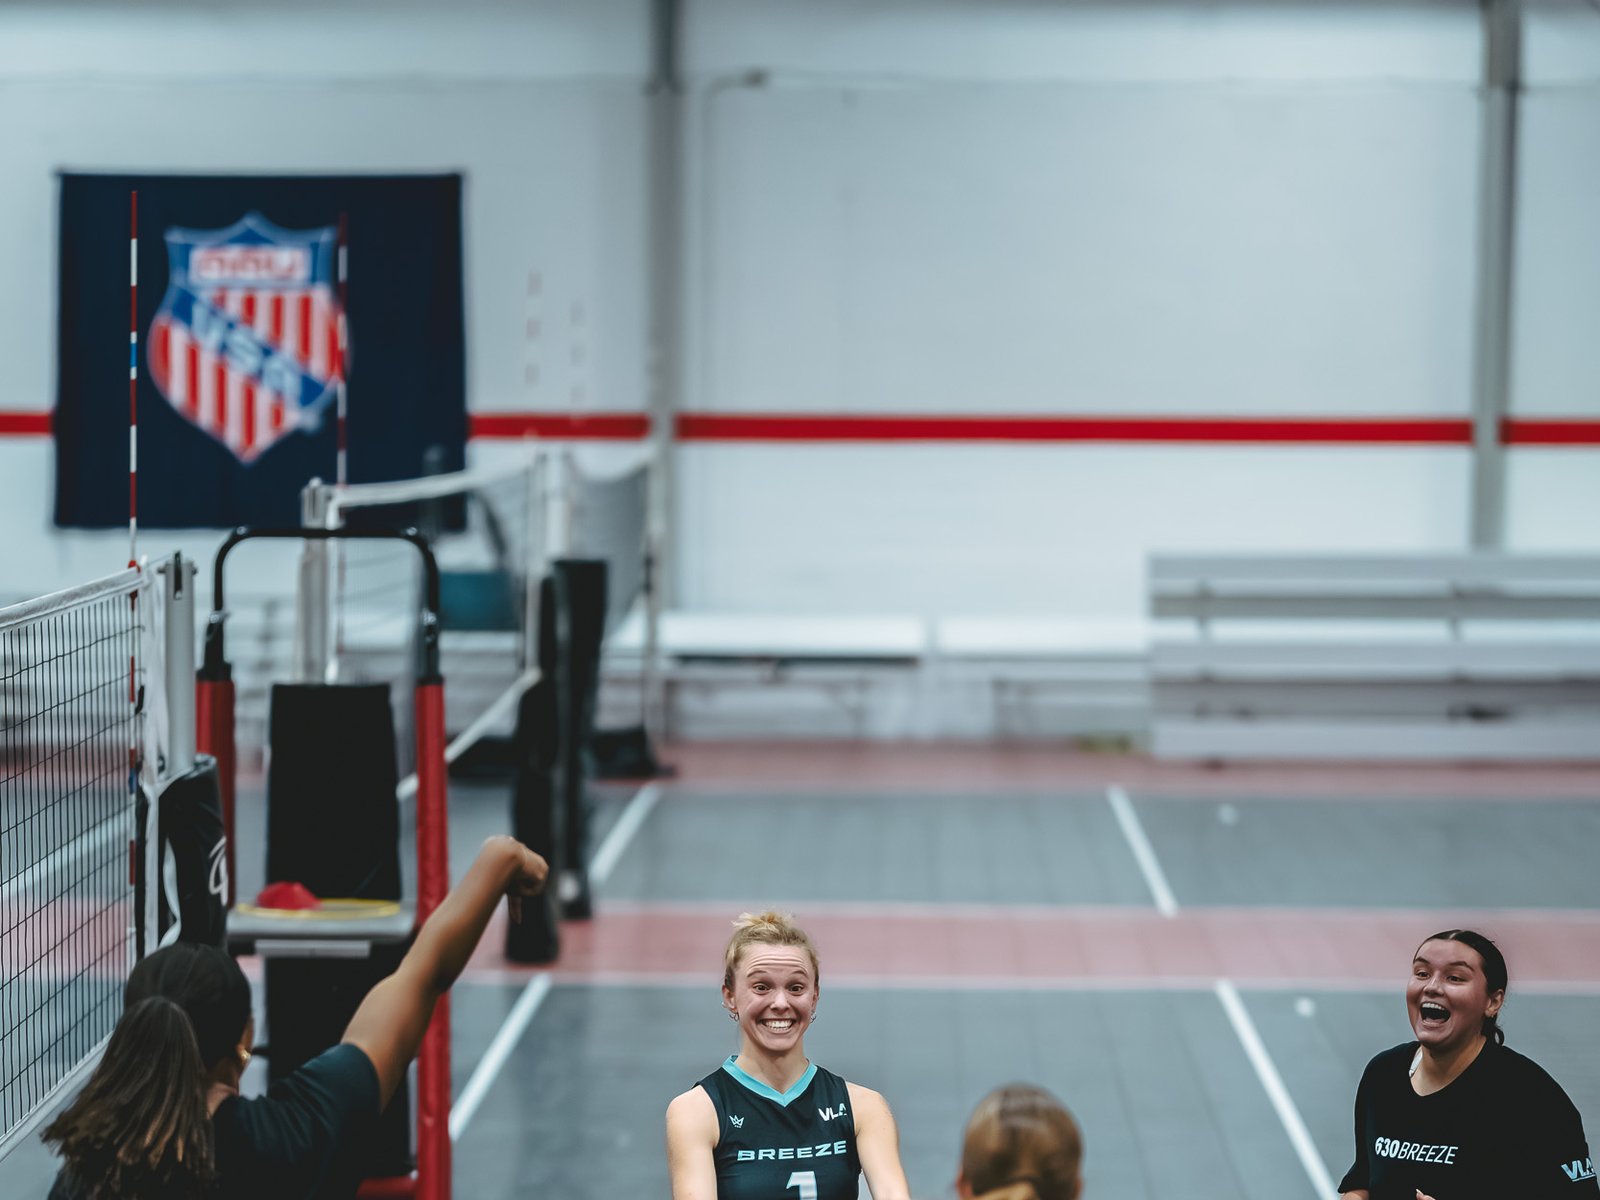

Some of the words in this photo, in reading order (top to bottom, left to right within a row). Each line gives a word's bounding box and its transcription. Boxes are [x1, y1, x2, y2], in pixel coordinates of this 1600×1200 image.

[190, 299, 301, 405] USA
[817, 1102, 848, 1122] VLA
[736, 1140, 847, 1162] BREEZE
